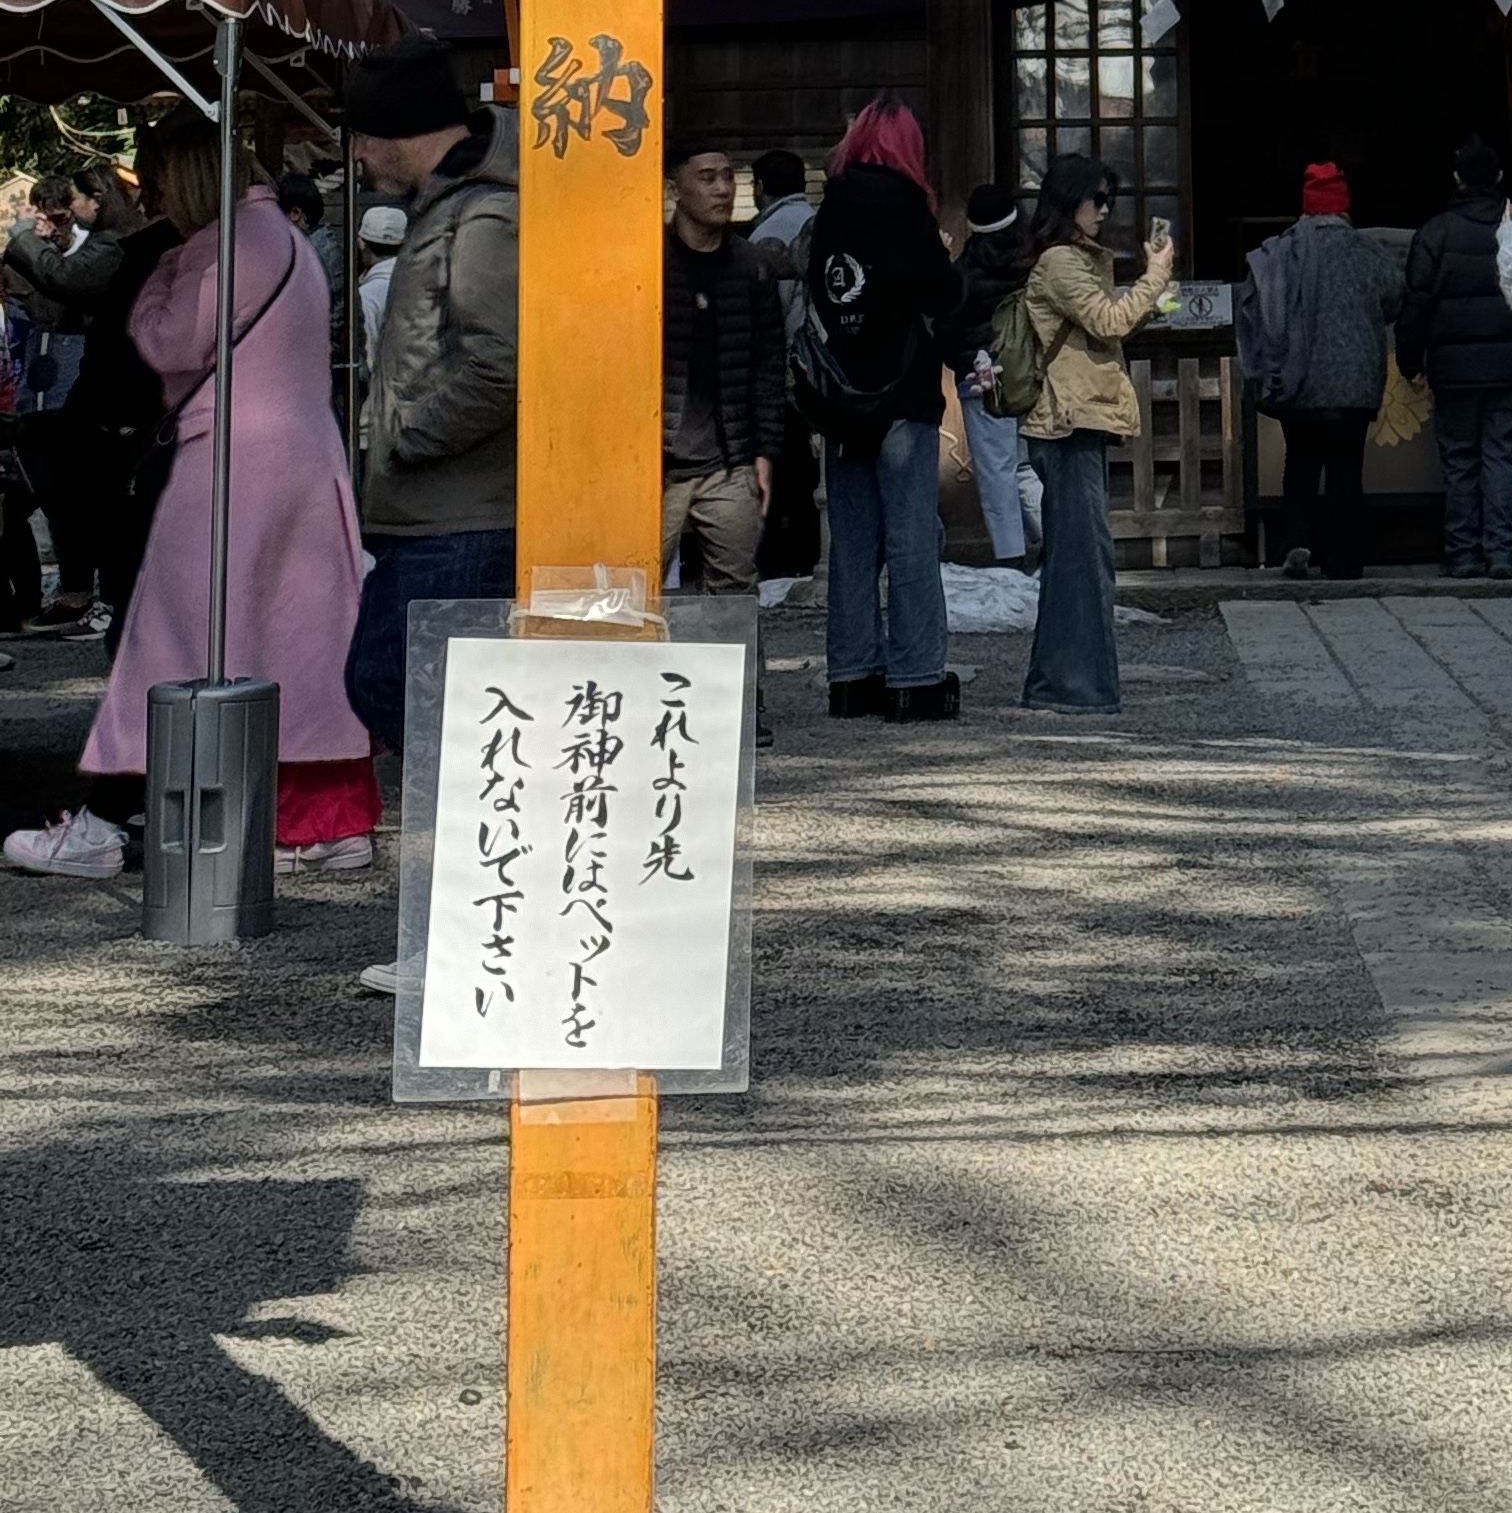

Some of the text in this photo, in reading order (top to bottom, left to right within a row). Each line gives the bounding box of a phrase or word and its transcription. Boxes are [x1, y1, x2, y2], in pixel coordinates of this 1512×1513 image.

[472, 686, 535, 1018] 入れないで下さい
[552, 680, 624, 1048] 御神前にはペットを
[638, 672, 700, 886] これより先
